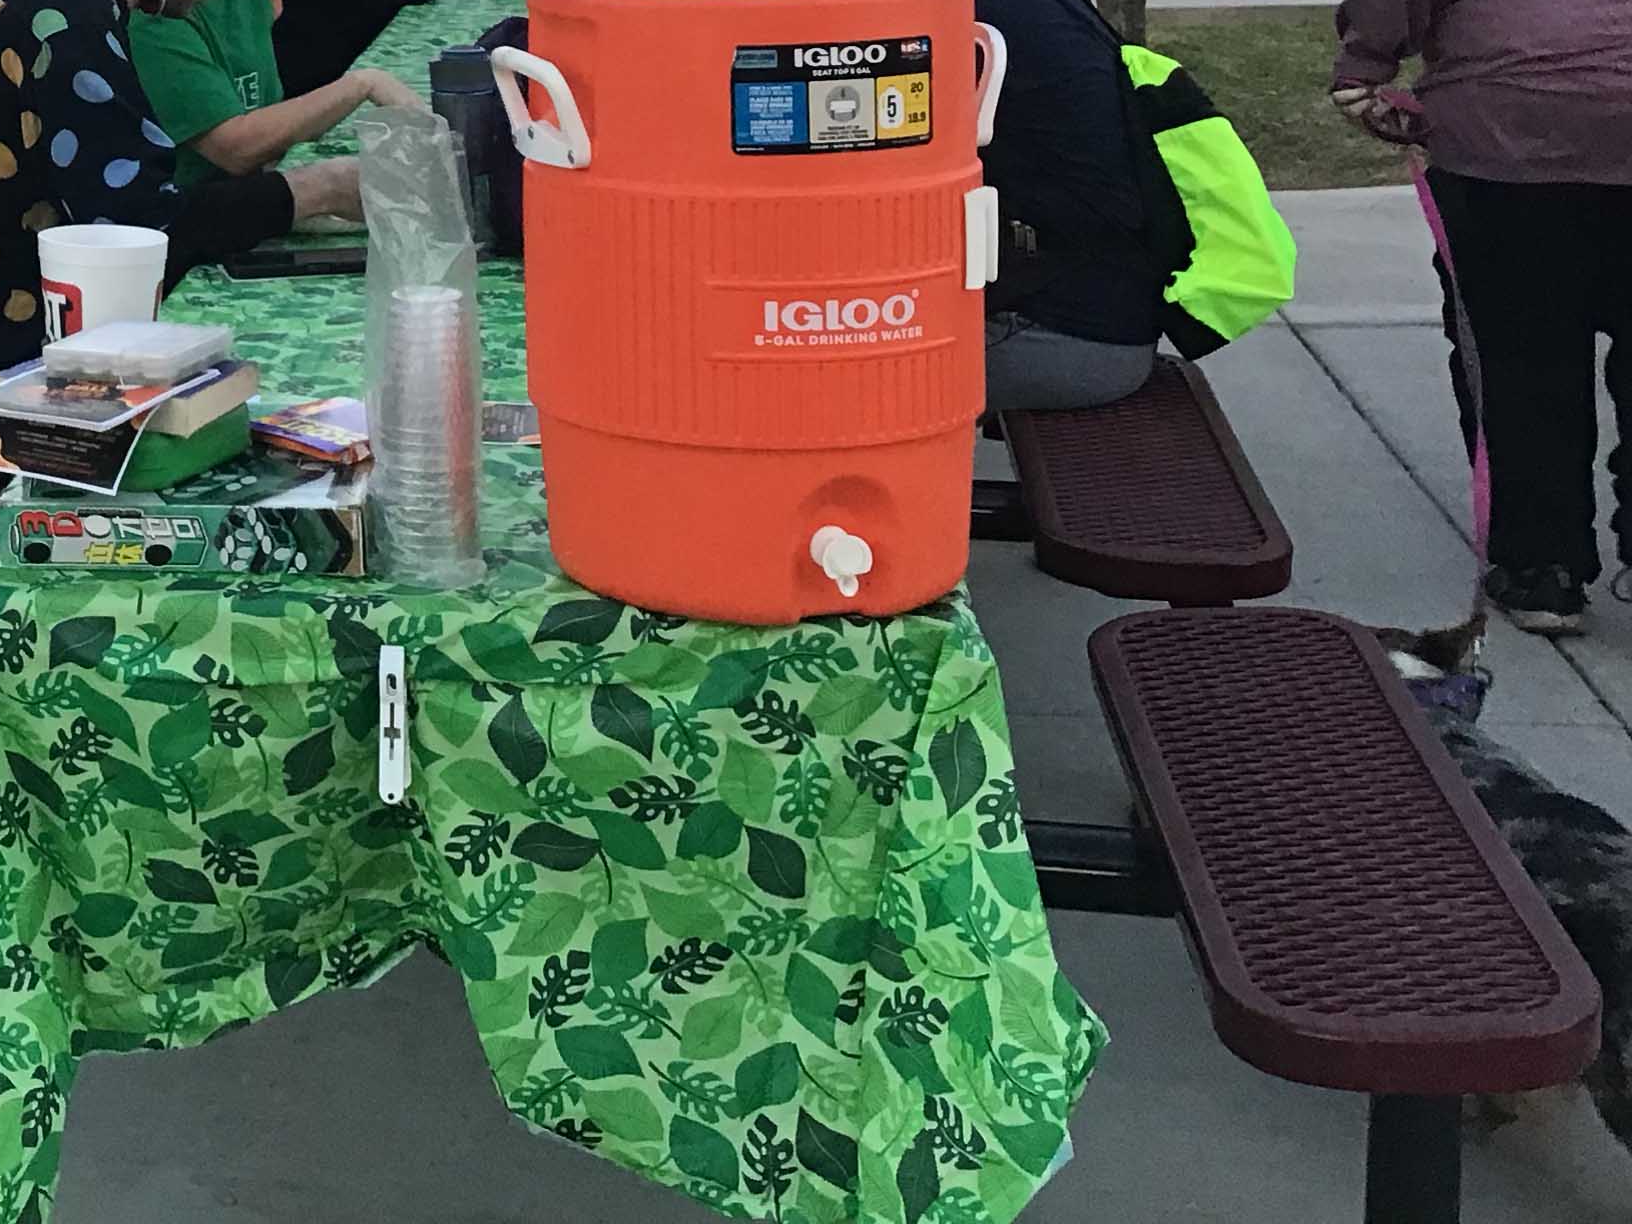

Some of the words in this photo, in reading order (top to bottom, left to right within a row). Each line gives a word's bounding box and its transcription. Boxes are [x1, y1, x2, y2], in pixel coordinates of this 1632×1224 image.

[794, 44, 886, 68] IGLOO
[812, 69, 833, 77] SEAT
[834, 68, 849, 76] TOP
[856, 67, 871, 75] GAL
[910, 81, 924, 93] 20
[887, 94, 897, 117] 5
[764, 294, 916, 332] IGLOO
[754, 334, 805, 346] 5-GAL
[809, 331, 877, 345] DRINKING
[881, 326, 923, 341] WATER
